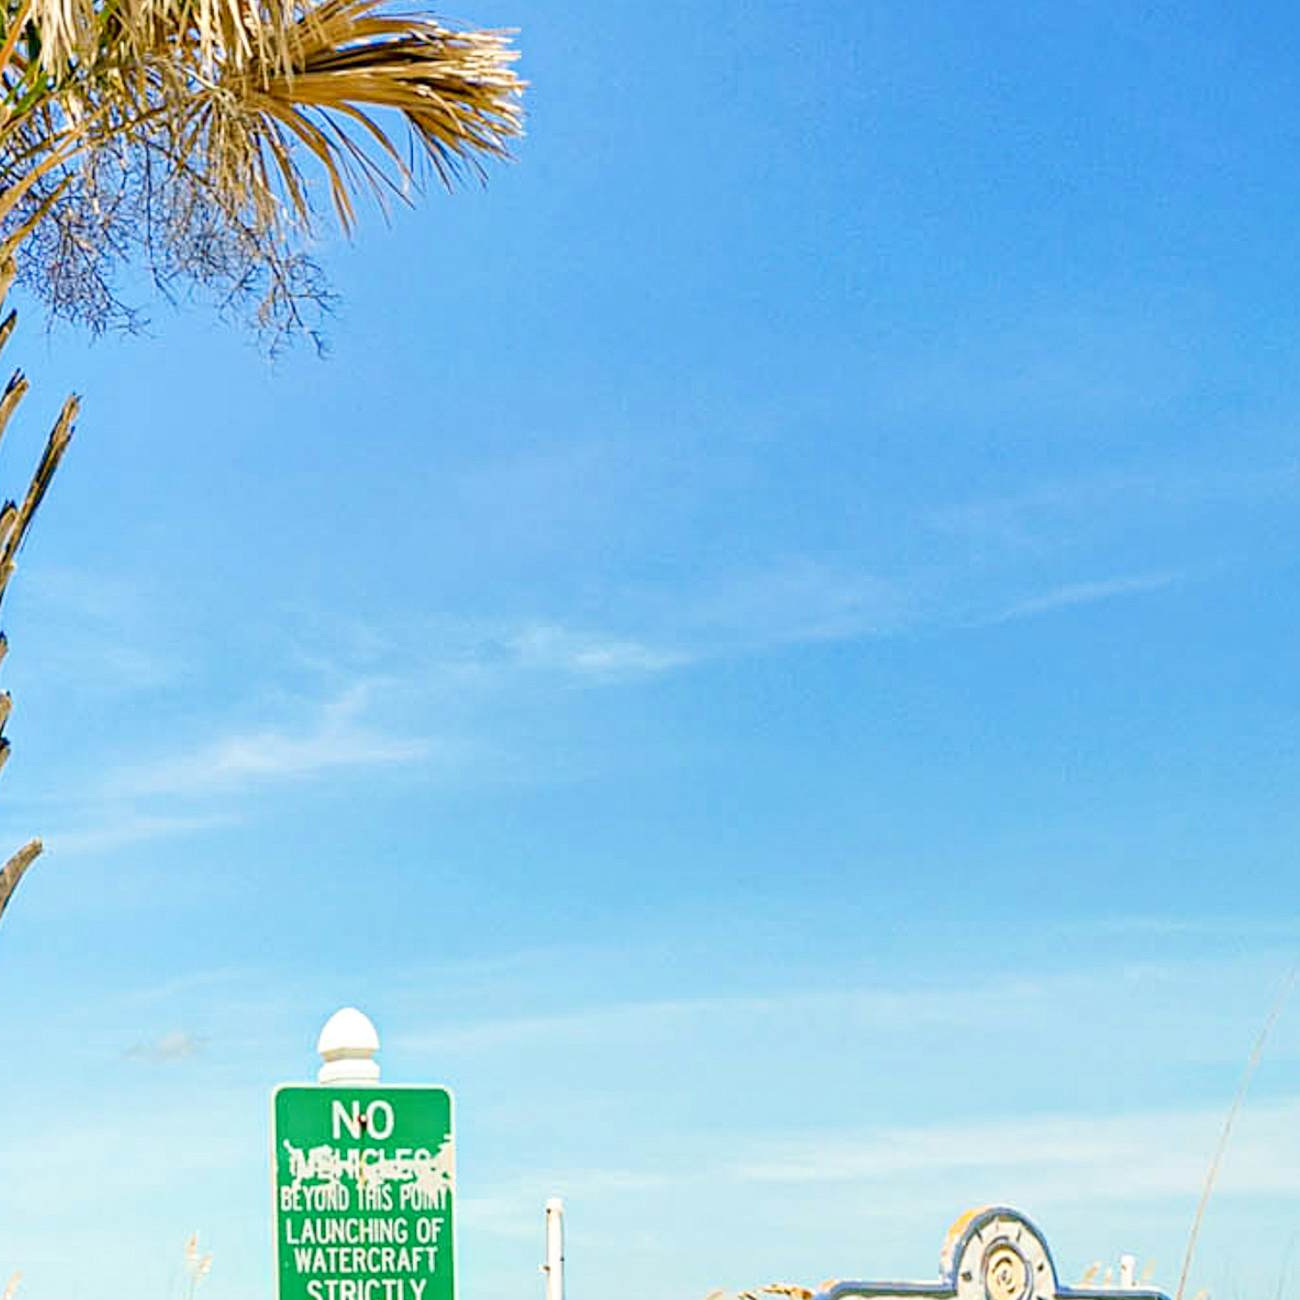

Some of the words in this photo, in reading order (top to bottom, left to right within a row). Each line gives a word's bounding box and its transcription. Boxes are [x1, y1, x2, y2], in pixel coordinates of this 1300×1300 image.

[331, 1100, 395, 1140] NO
[280, 1185, 350, 1212] BEYOND
[357, 1185, 394, 1212] THIS
[399, 1183, 448, 1212] POINT
[285, 1218, 409, 1245] LAUNCHING
[416, 1218, 444, 1243] OF
[294, 1247, 438, 1273] WATERCRAFT
